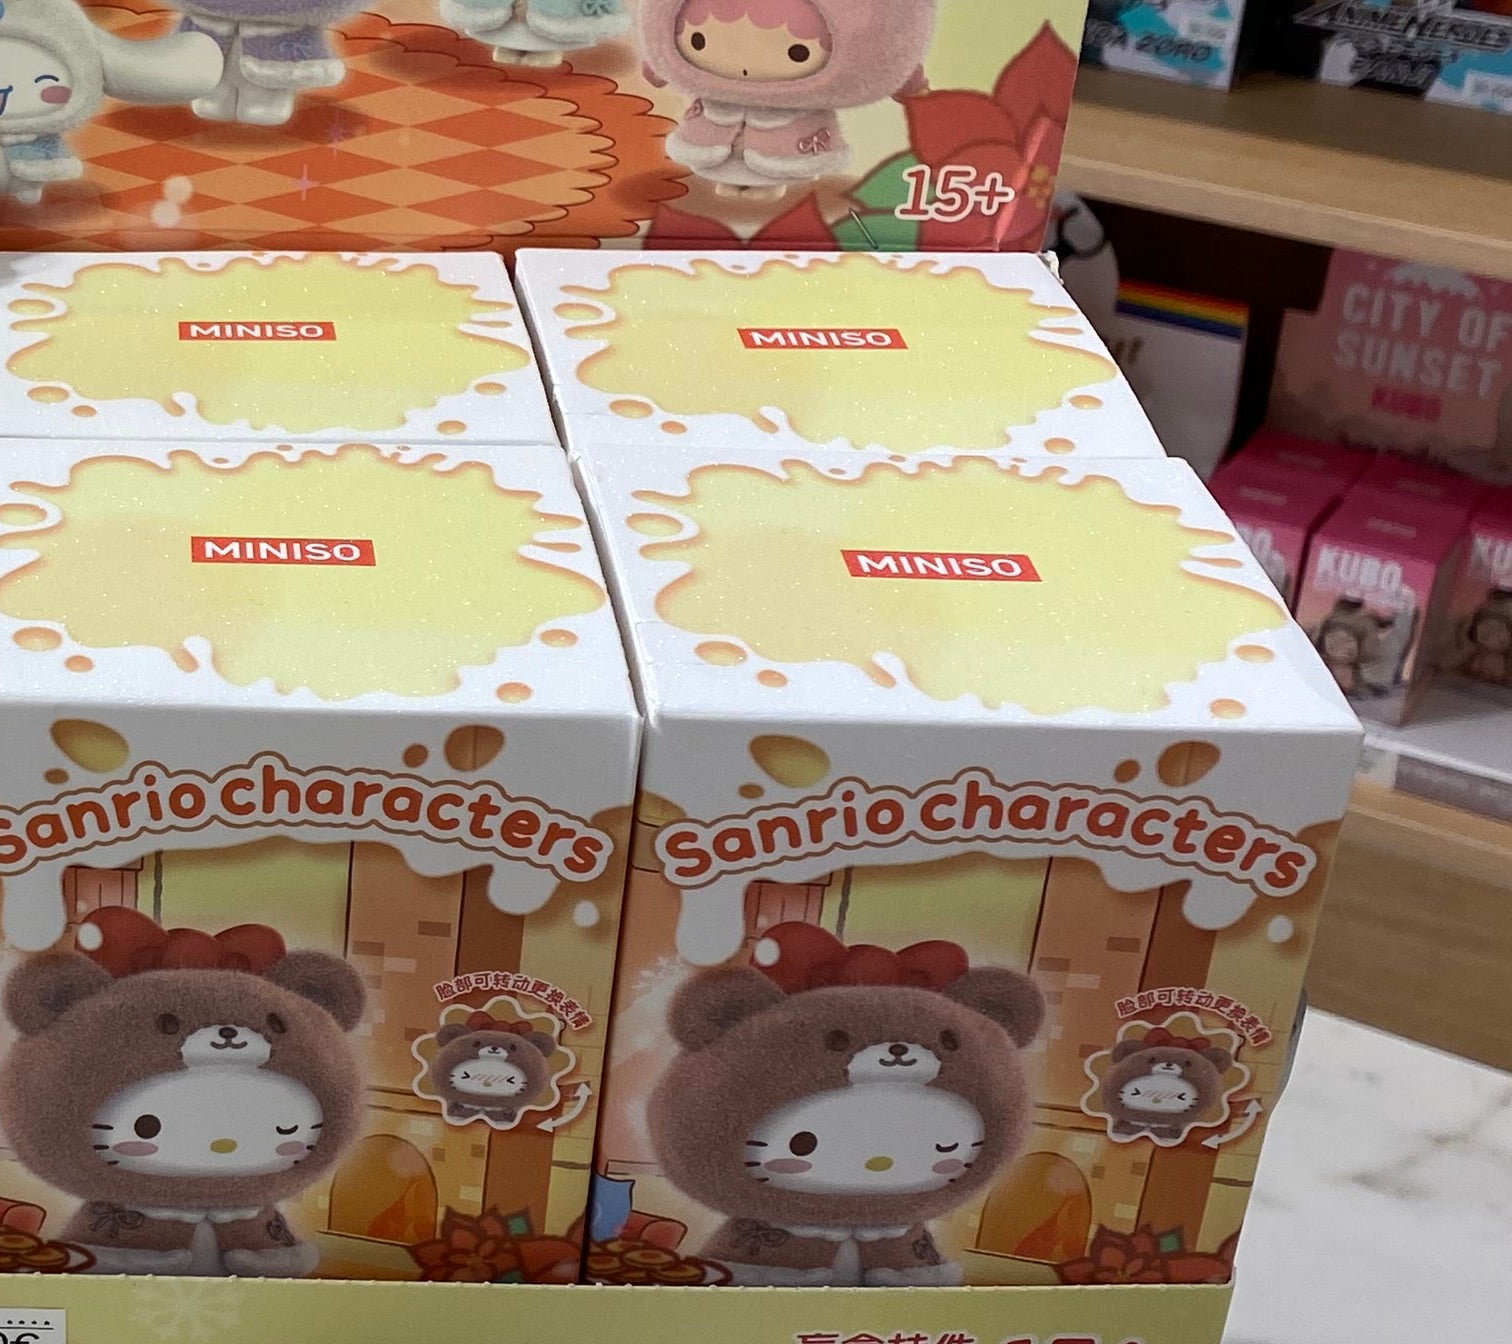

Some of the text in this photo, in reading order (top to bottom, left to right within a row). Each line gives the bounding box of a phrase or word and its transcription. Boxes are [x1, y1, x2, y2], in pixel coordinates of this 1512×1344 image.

[897, 168, 1014, 220] 15+
[189, 323, 324, 339] MINISO
[1343, 282, 1441, 338] CITY
[750, 329, 892, 348] MINISO
[1336, 331, 1502, 400] SUNSET
[203, 540, 362, 562] MINISO
[857, 555, 1023, 579] MINISO
[220, 764, 604, 875] characters
[664, 780, 1308, 890] Sanrio characters
[435, 972, 592, 1030] 脸部可转动更换表情
[1117, 988, 1272, 1046] 脸部可转动更换表情
